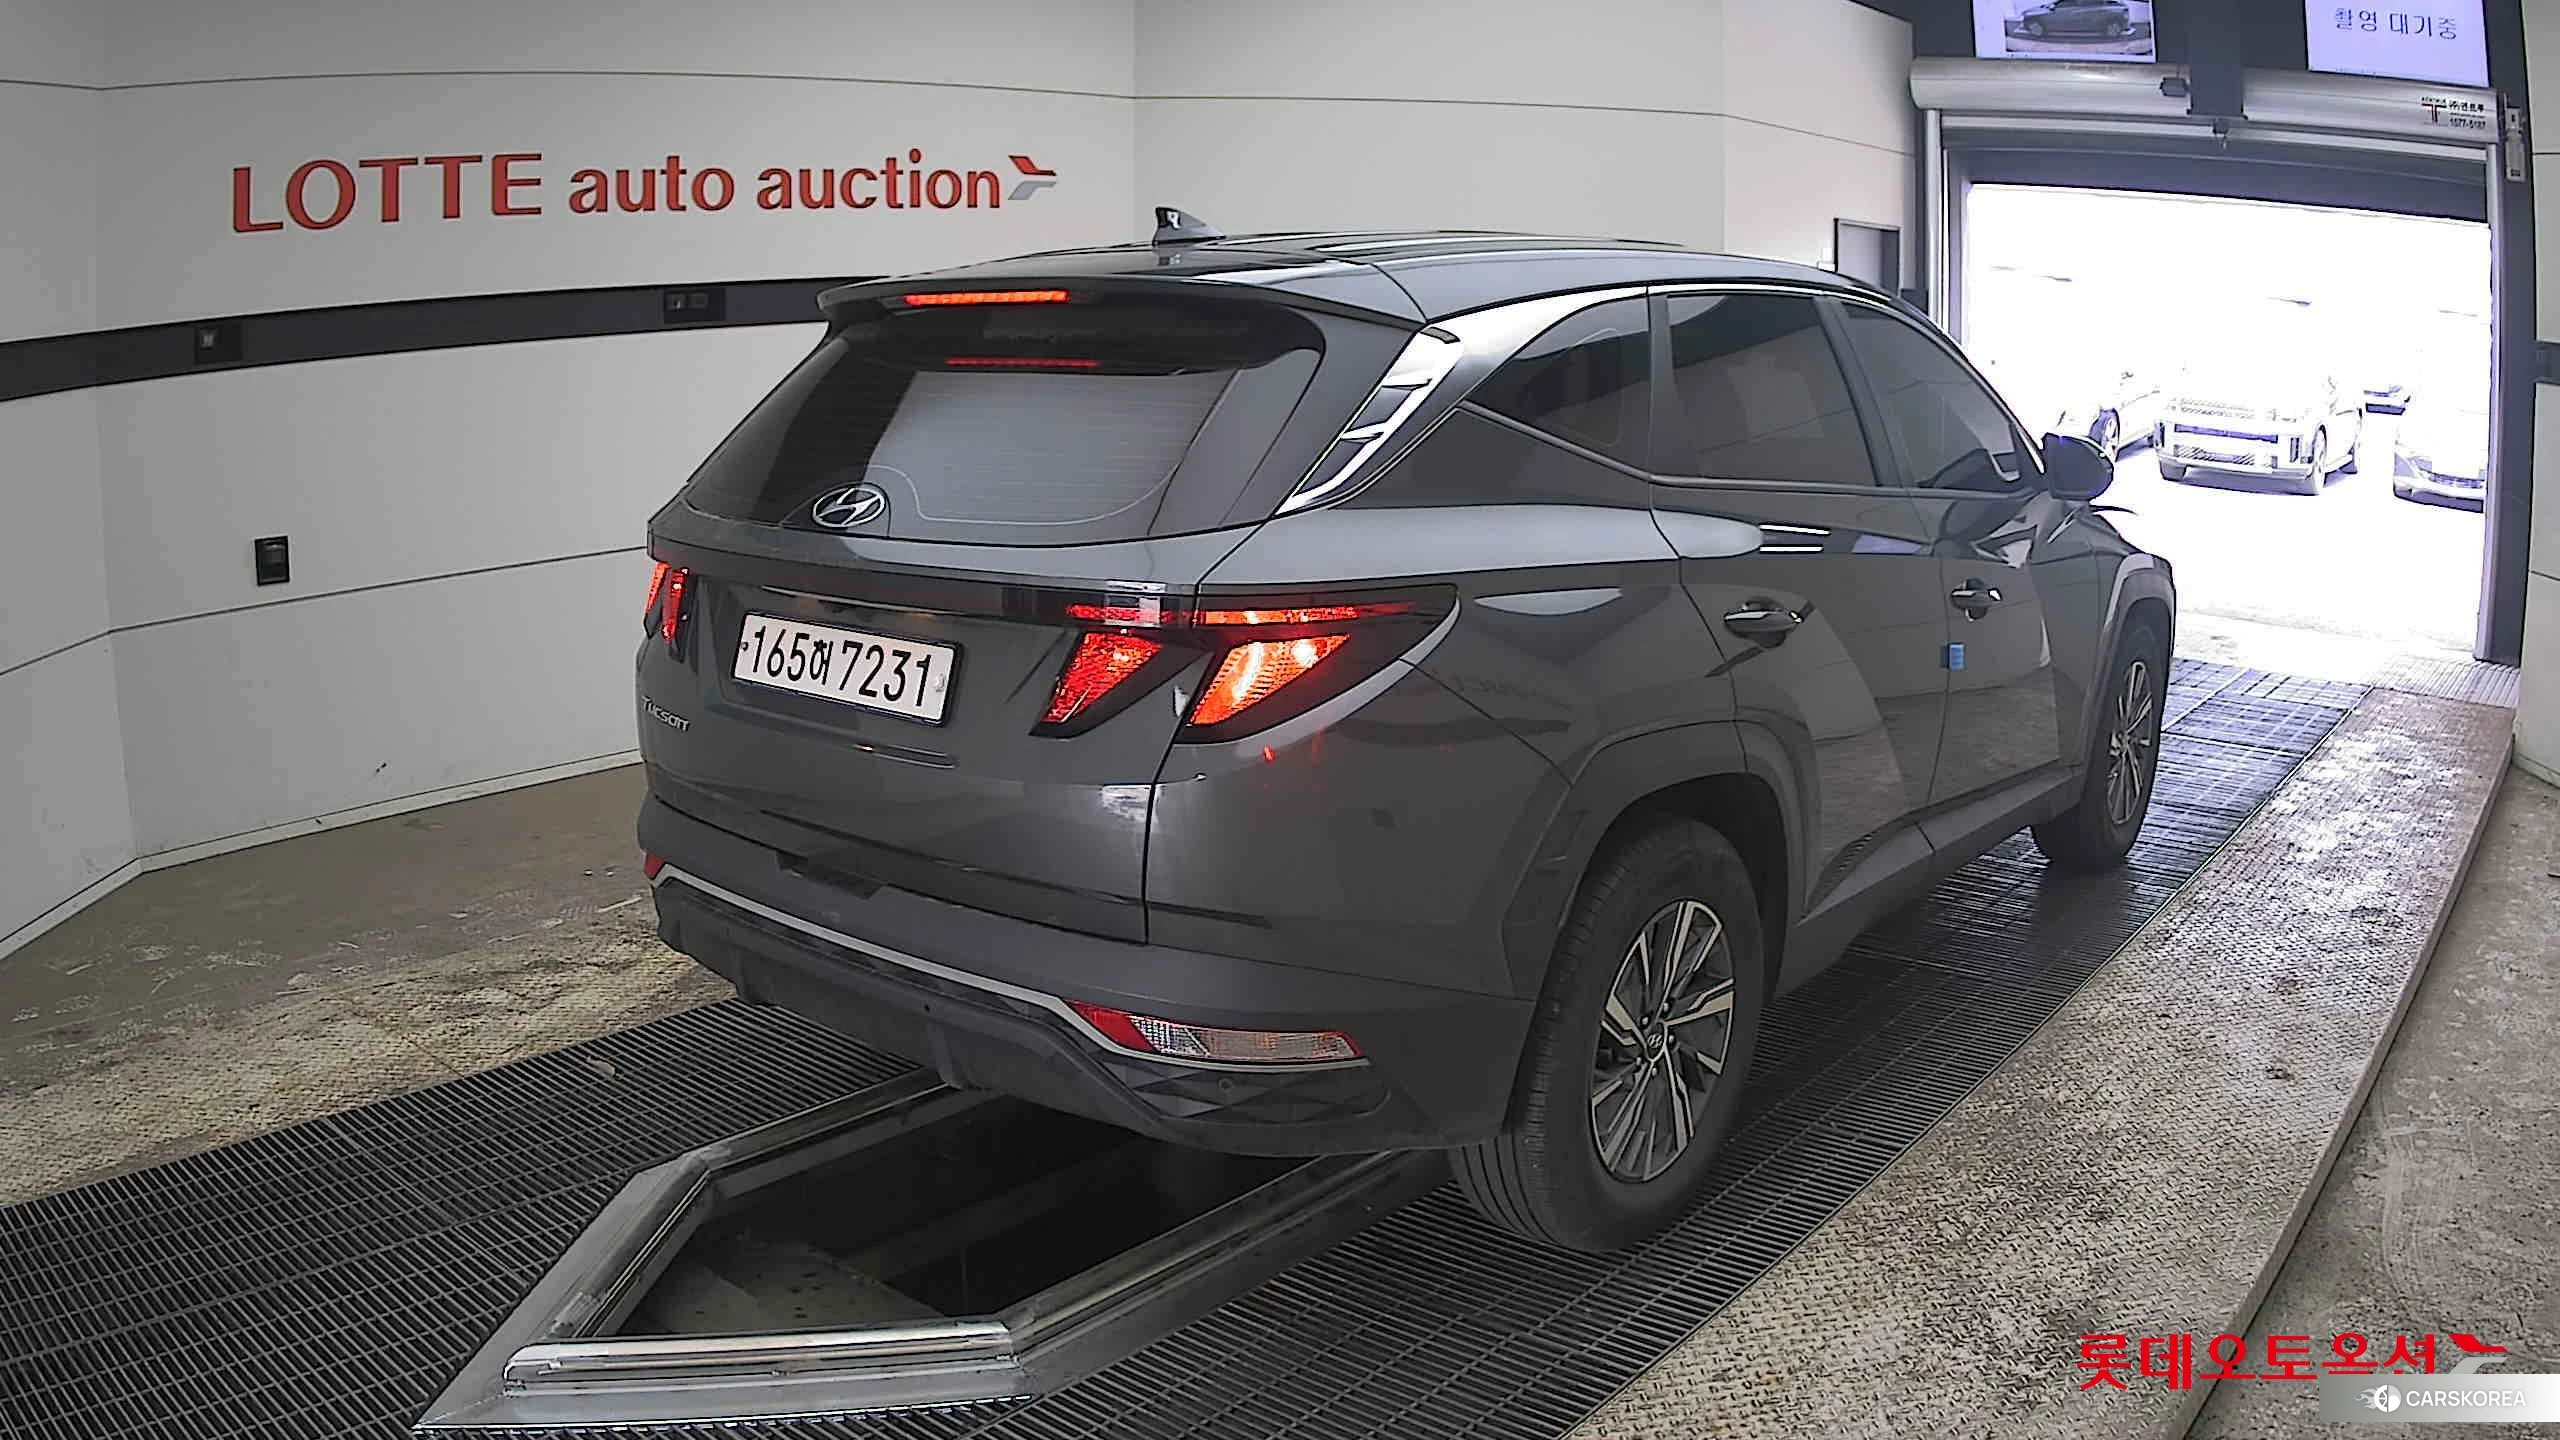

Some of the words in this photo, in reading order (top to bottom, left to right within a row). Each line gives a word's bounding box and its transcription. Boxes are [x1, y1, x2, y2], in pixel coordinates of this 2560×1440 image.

[2389, 12, 2456, 40] 대기중
[234, 153, 542, 233] LOTTE
[569, 156, 735, 214] auto
[757, 148, 1000, 210] auction
[752, 625, 833, 686] 165허
[838, 640, 932, 706] 7231
